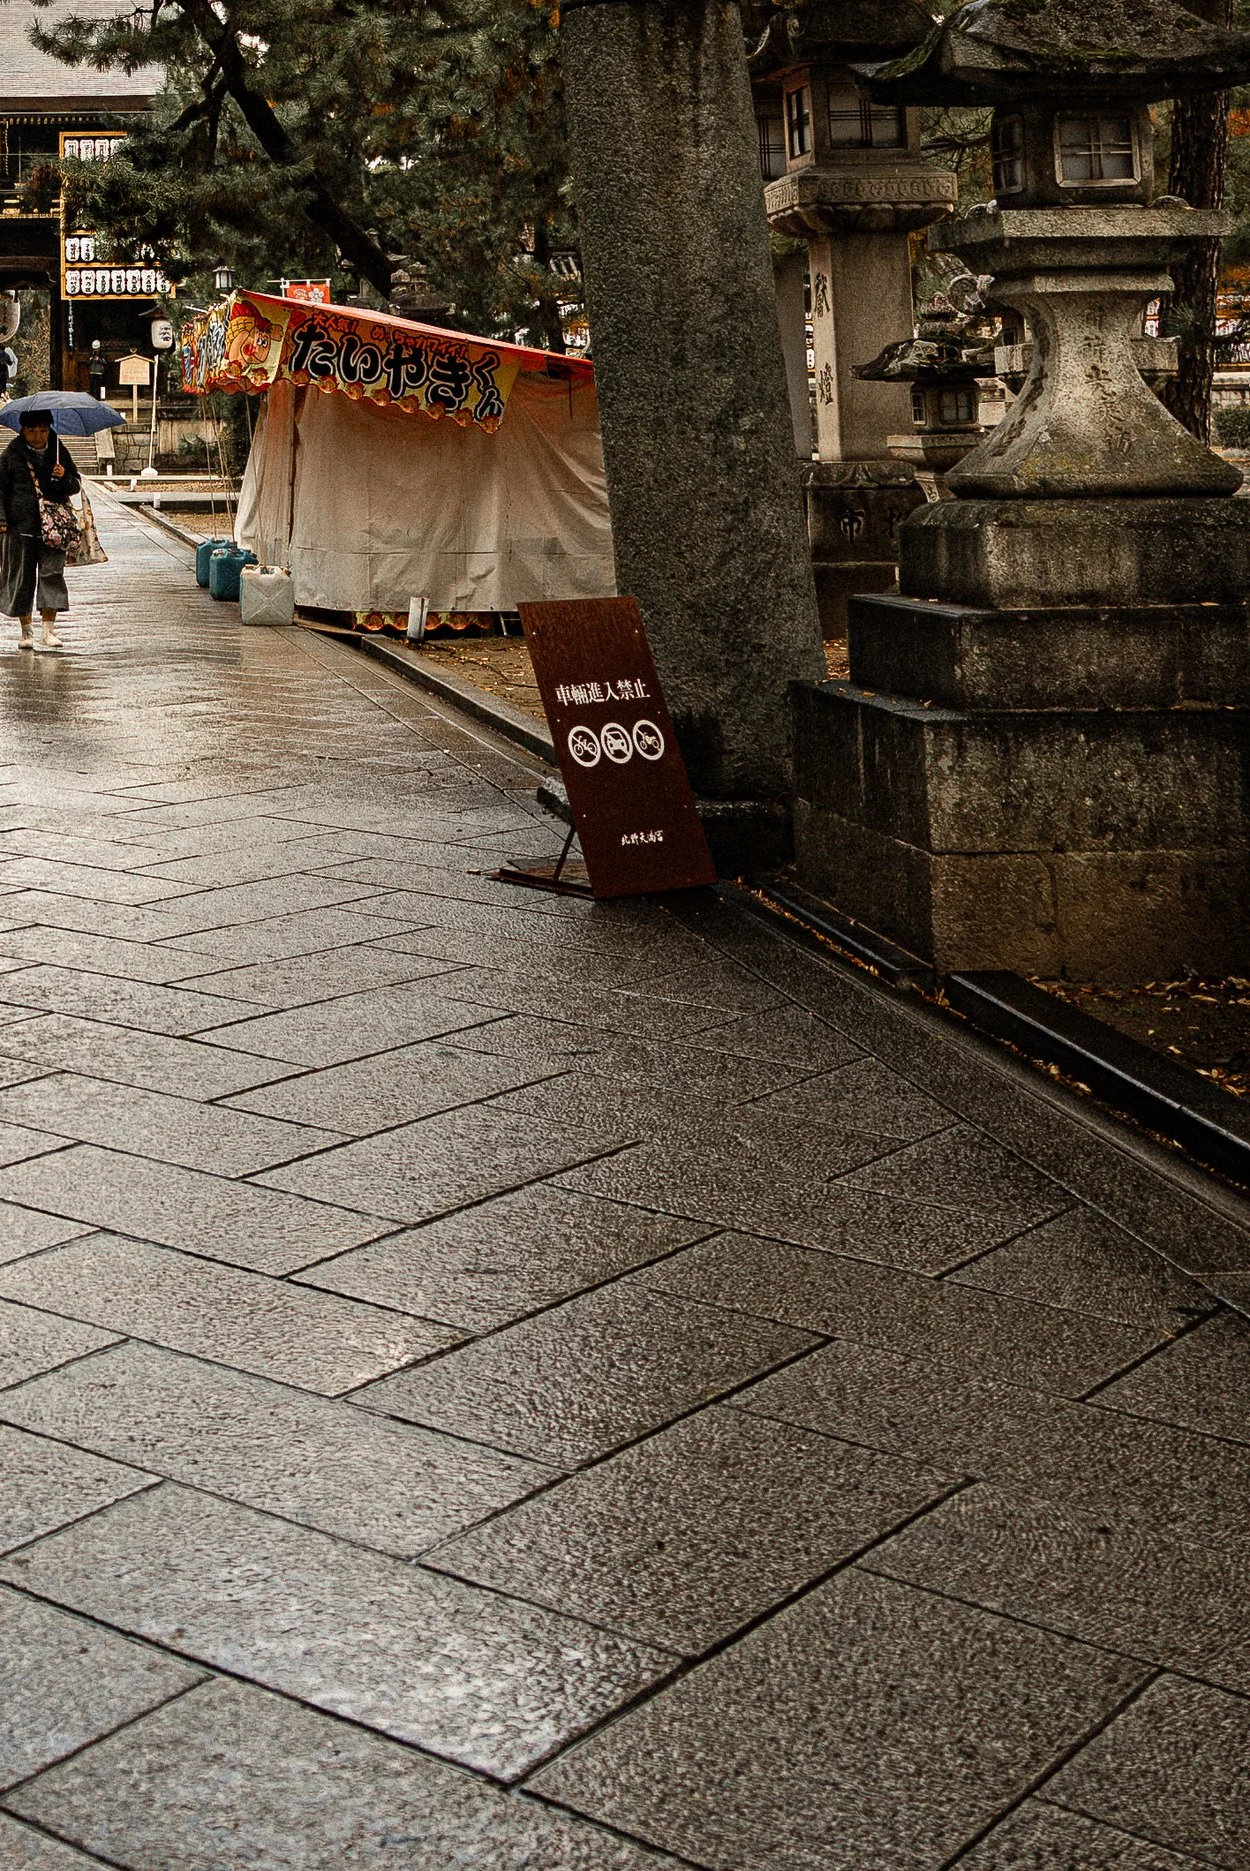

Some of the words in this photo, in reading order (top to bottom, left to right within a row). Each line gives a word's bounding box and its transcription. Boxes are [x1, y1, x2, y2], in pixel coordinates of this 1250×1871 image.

[288, 322, 505, 424] たいやきくん
